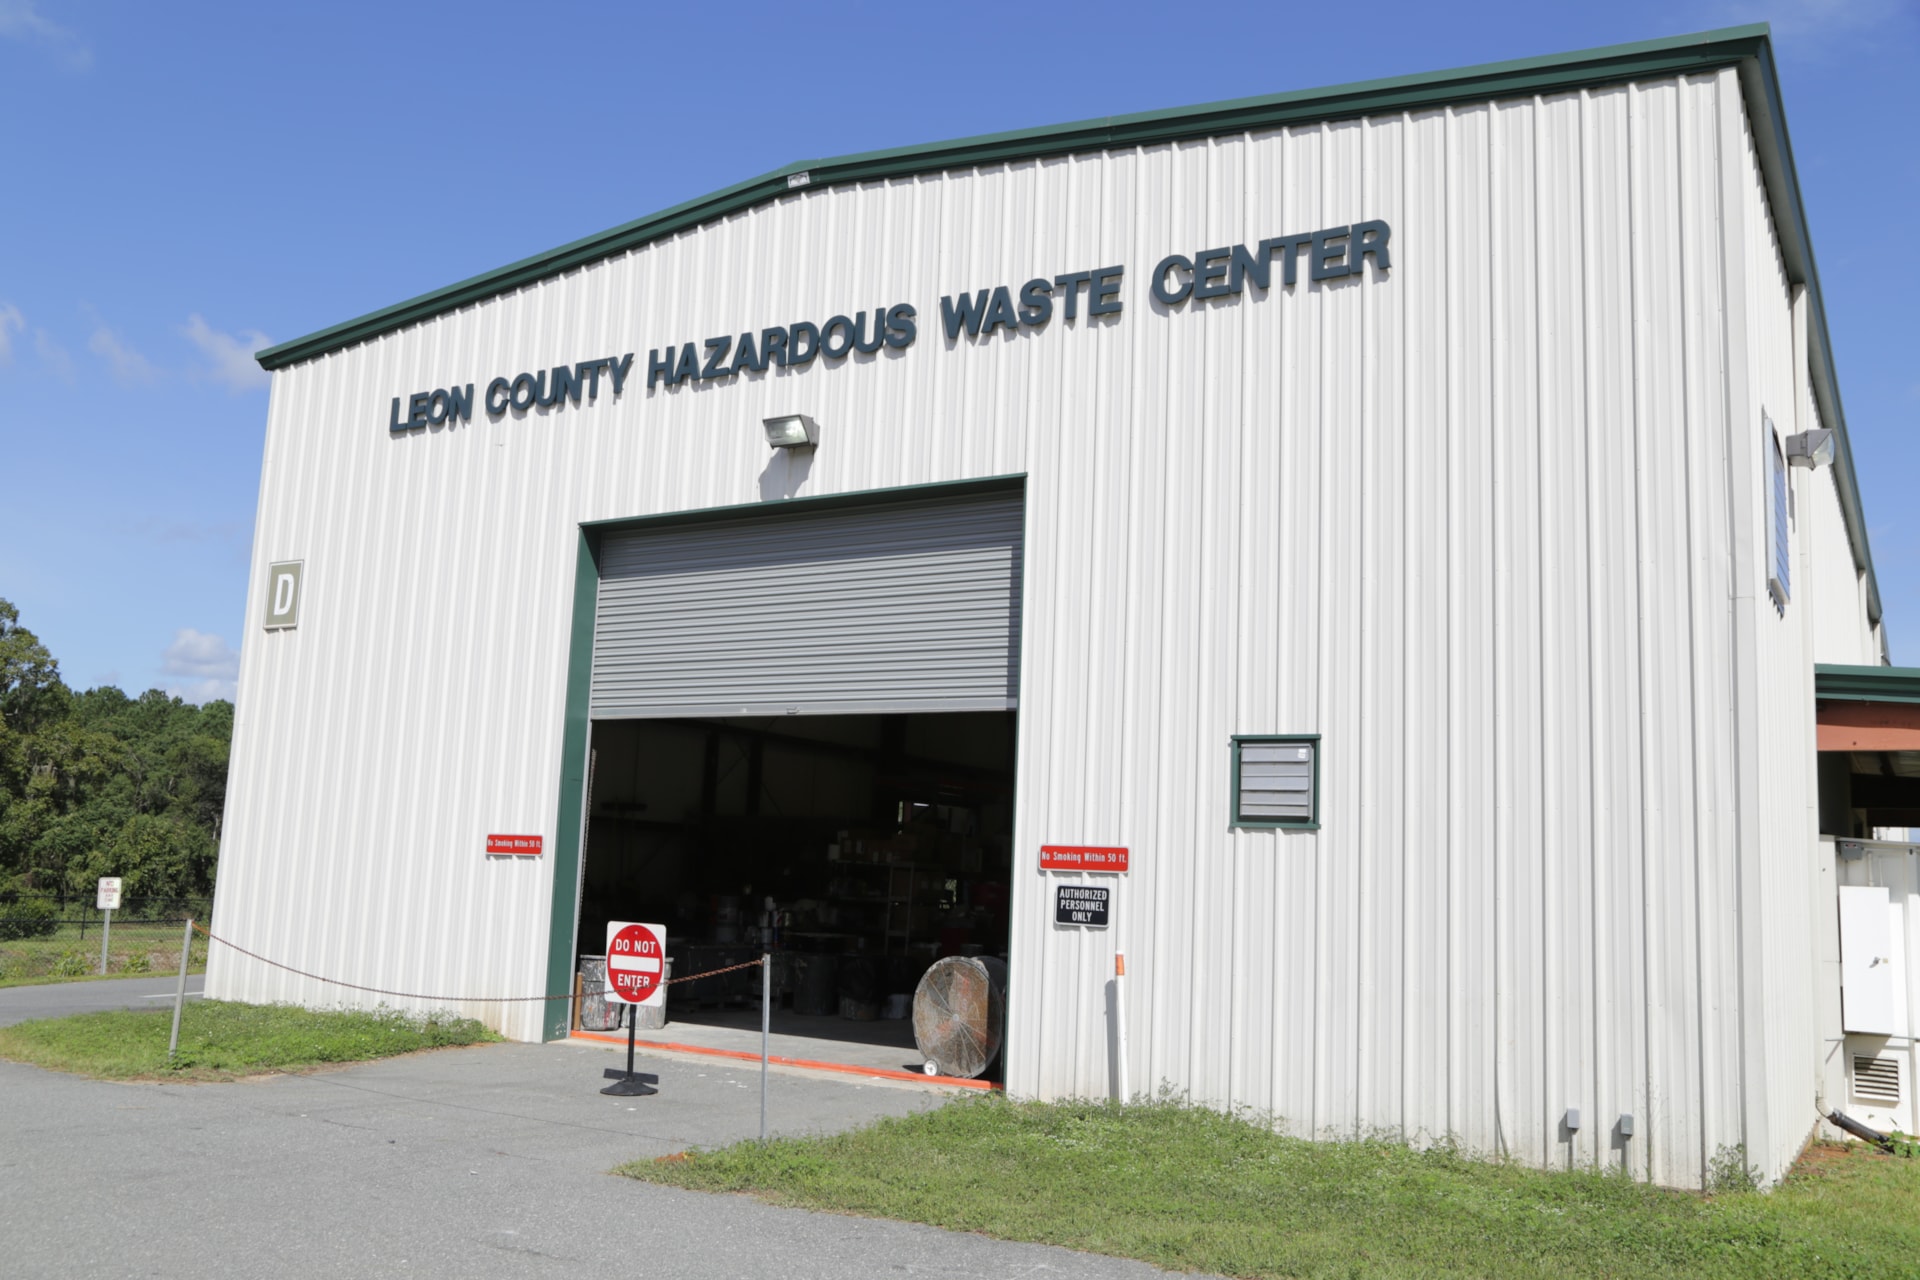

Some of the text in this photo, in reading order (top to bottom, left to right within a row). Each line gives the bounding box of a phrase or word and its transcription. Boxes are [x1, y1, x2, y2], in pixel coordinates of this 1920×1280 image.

[390, 219, 1392, 432] LEON COUNTY HAZARDOUS WASTE CENTER
[273, 573, 294, 616] D
[1042, 851, 1050, 860] No
[1053, 852, 1081, 864] Smoking
[1084, 853, 1105, 862] Within
[1108, 853, 1116, 862] 50
[1059, 888, 1107, 900] AUTHORIZED
[1060, 900, 1104, 911] PERSONNEL
[1072, 911, 1092, 922] ONLY
[615, 938, 656, 954] DO NOT
[617, 973, 650, 988] ENTER
